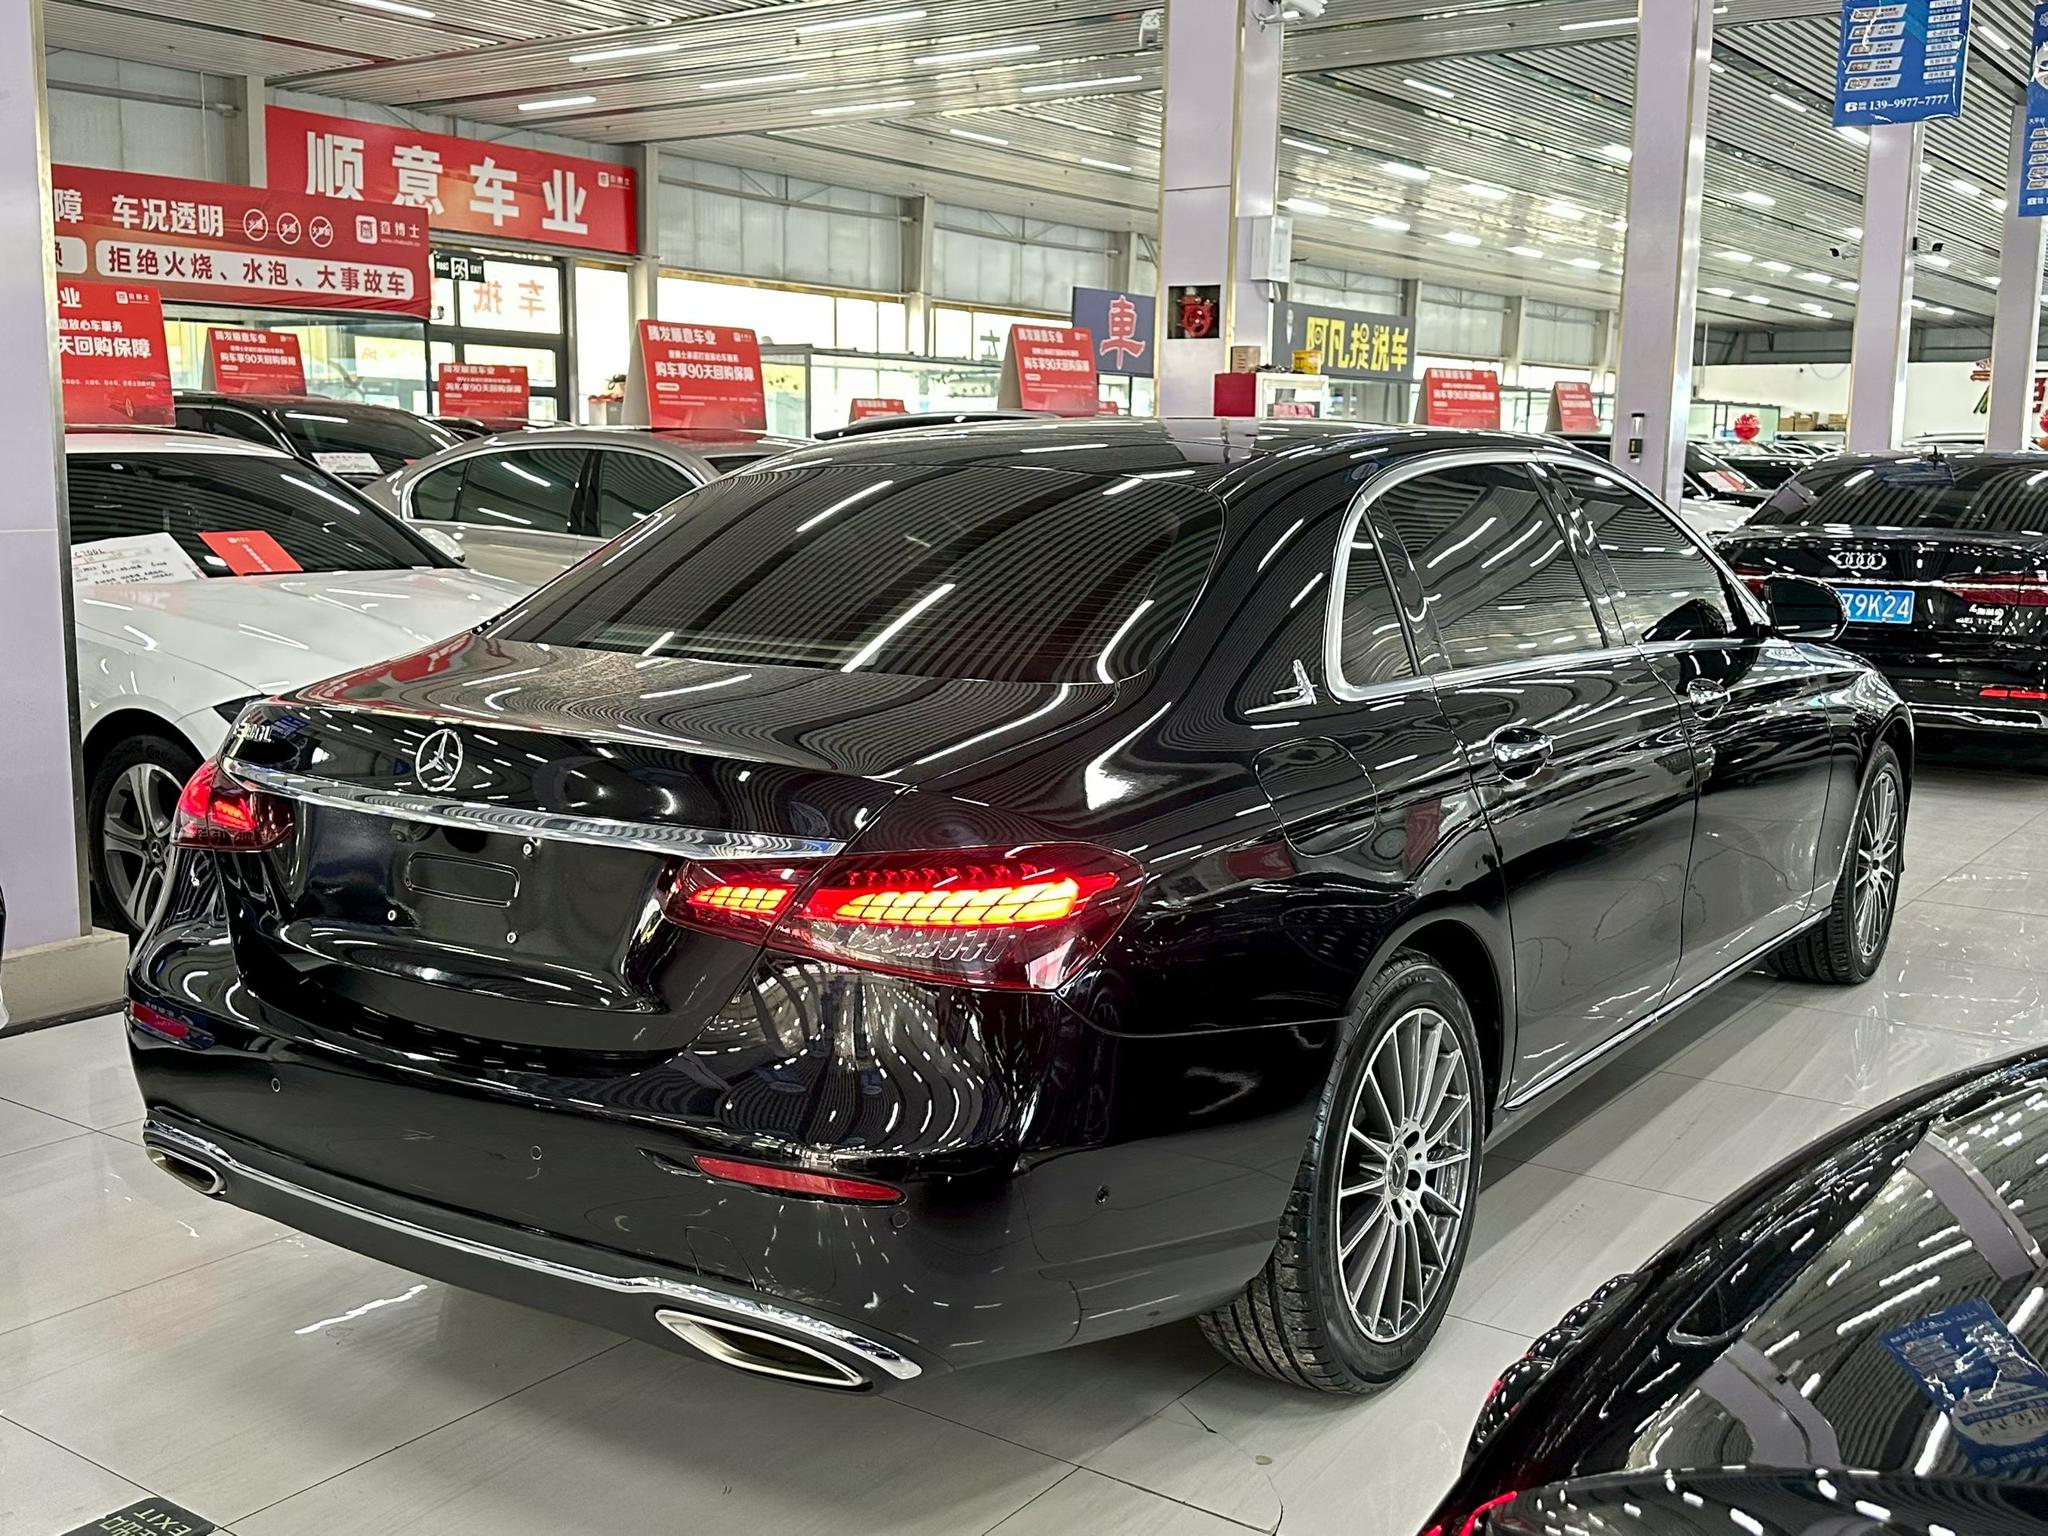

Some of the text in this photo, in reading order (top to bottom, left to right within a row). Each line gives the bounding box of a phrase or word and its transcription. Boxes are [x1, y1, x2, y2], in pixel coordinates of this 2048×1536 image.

[1869, 94, 1949, 111] 139-9977-7777
[305, 131, 588, 235] 顺意车业
[112, 194, 224, 237] 车况透明
[108, 246, 406, 296] 拒绝火烧、水泡、大事故车
[57, 287, 82, 308] 业
[59, 335, 151, 358] 天回购保障
[1100, 295, 1146, 370] 車
[655, 361, 755, 381] 购车享90天回购保障
[133, 1508, 192, 1536] EXIT
